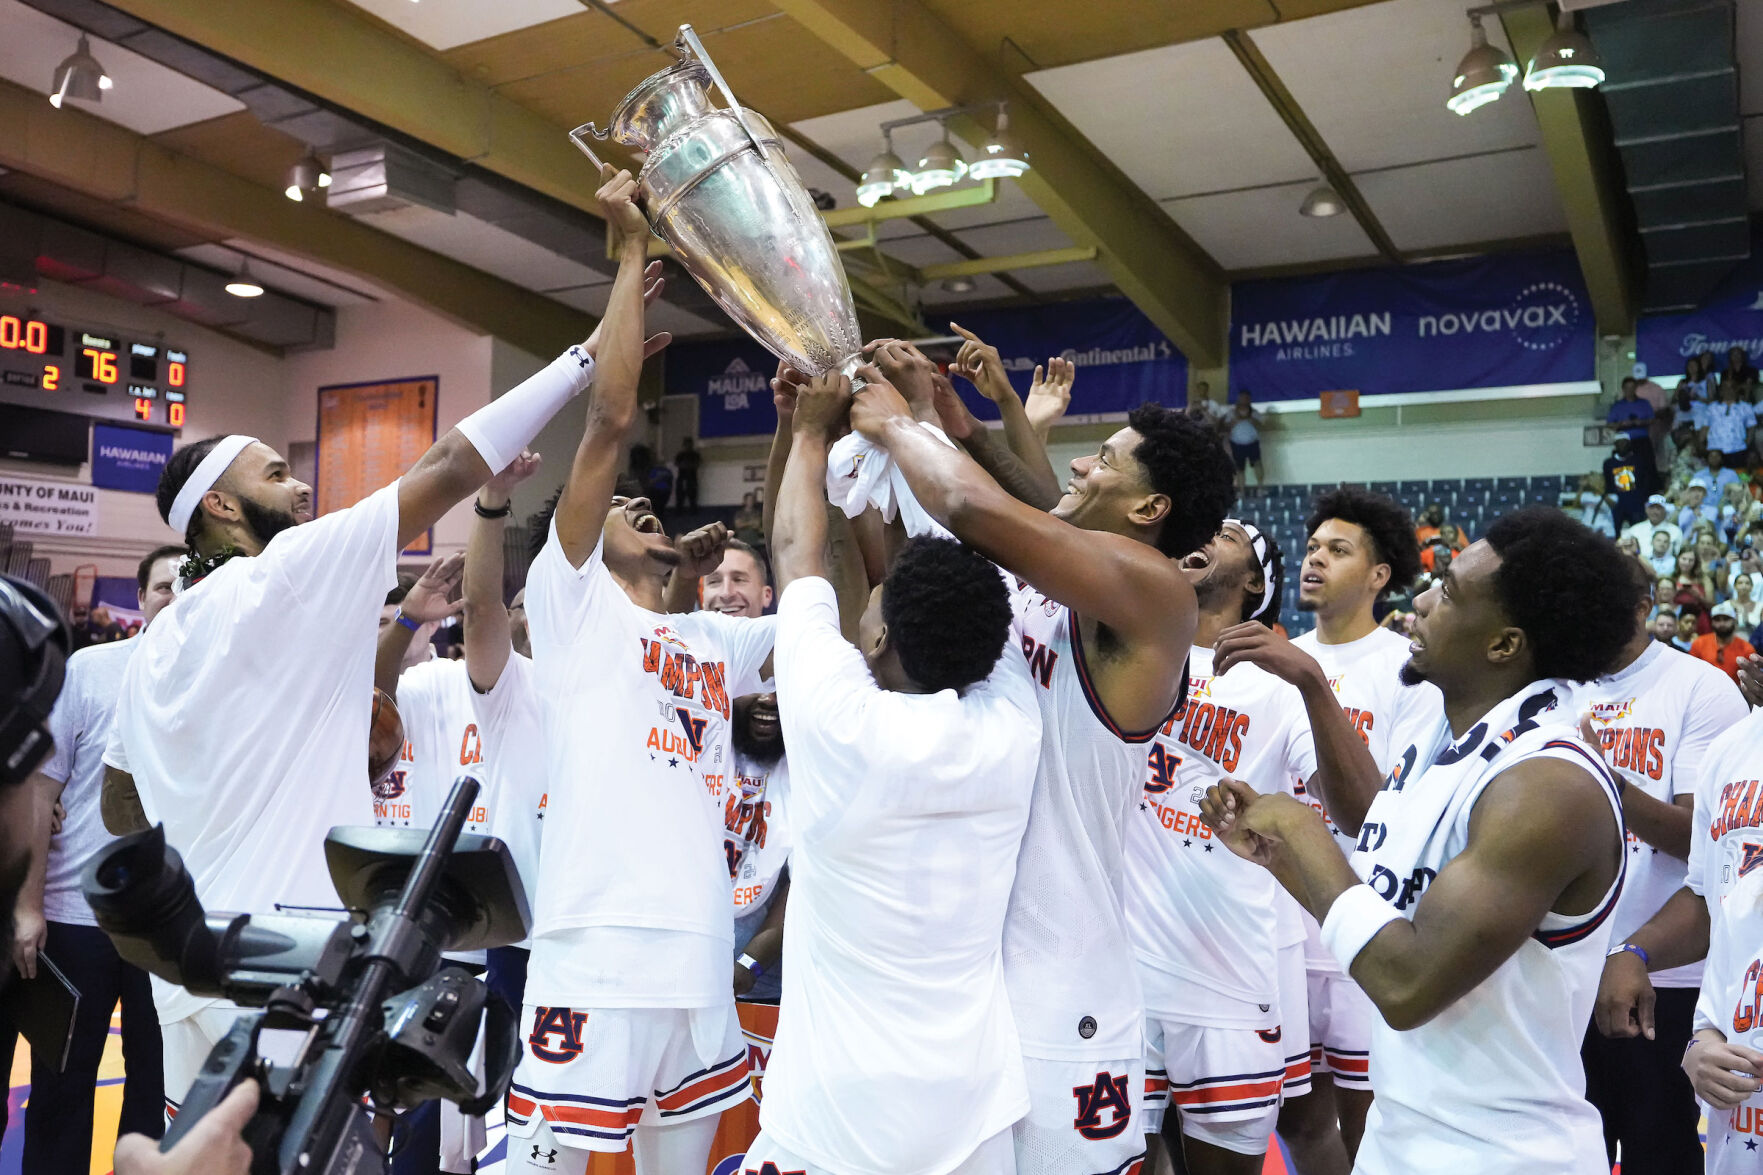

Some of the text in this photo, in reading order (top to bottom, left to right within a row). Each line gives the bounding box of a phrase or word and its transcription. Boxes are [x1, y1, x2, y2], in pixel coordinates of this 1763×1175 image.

[1241, 312, 1392, 347] HAWAIIAN
[1419, 303, 1567, 337] novavax
[1059, 342, 1157, 367] Continental
[1276, 342, 1353, 361] AIRLINES
[42, 365, 60, 390] 2
[82, 348, 118, 384] 76
[168, 362, 185, 387] 0
[708, 376, 767, 396] MAUNA
[134, 398, 151, 421] 4
[169, 402, 185, 427] 0
[100, 446, 166, 464] HAWAIIAN
[36, 486, 54, 499] OF
[58, 488, 94, 504] MAUI
[24, 503, 90, 517] Recreation
[0, 517, 93, 534] comes You!
[1072, 1071, 1131, 1140] AU
